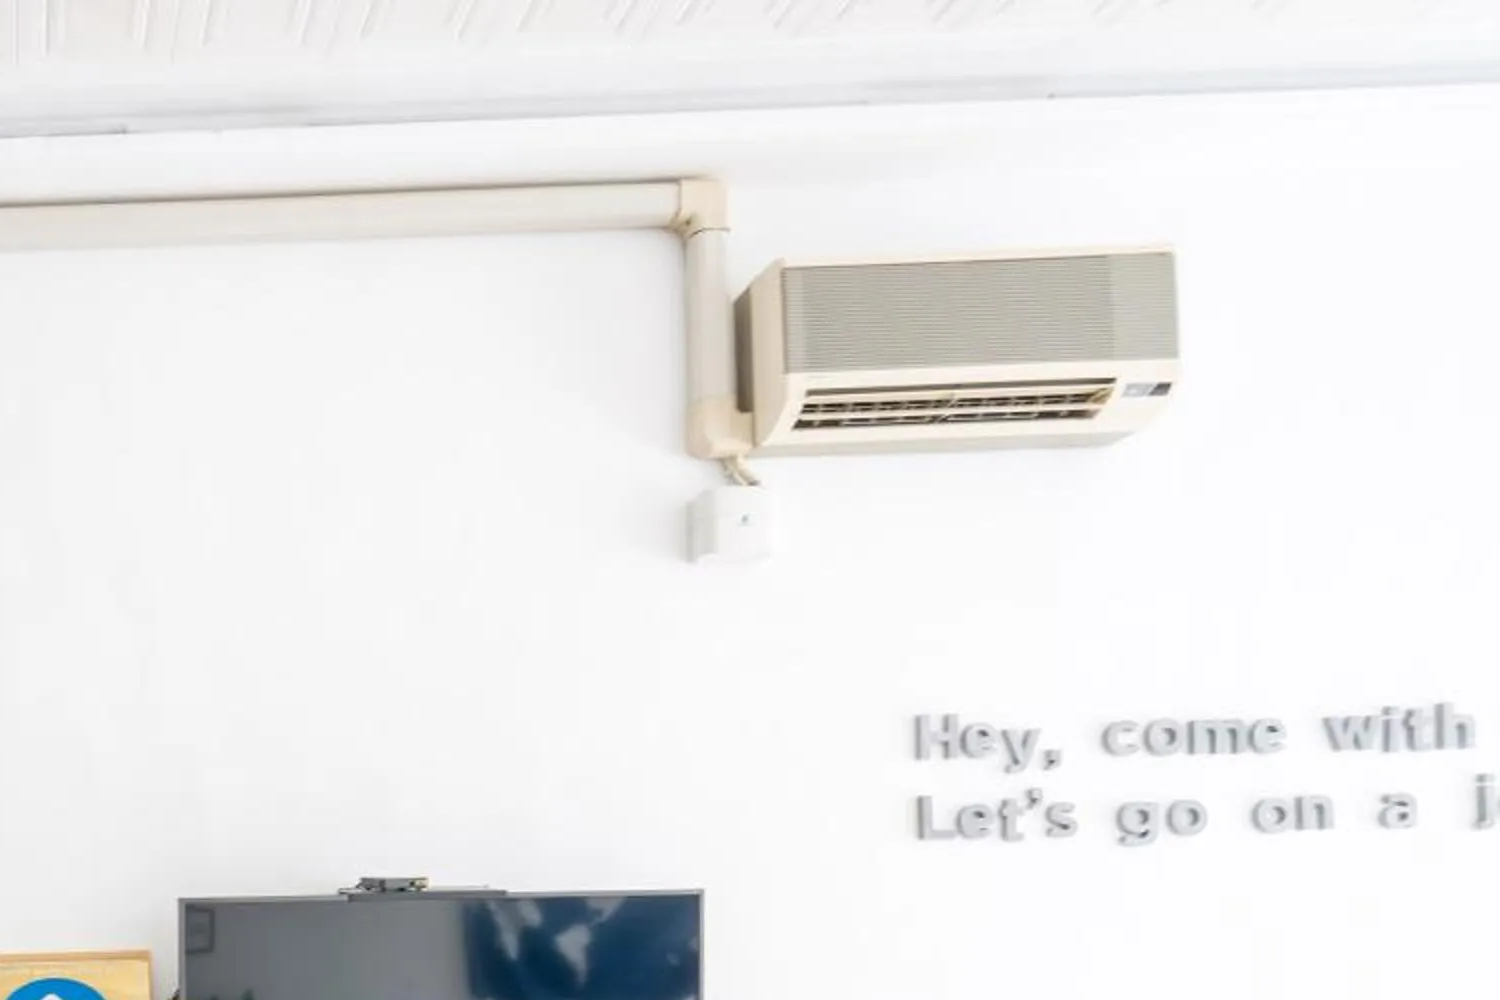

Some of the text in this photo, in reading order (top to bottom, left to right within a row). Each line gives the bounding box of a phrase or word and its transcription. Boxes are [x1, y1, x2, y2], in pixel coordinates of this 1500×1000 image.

[912, 702, 1476, 773] Hey, come with
[915, 772, 1500, 846] Let's go on a j
